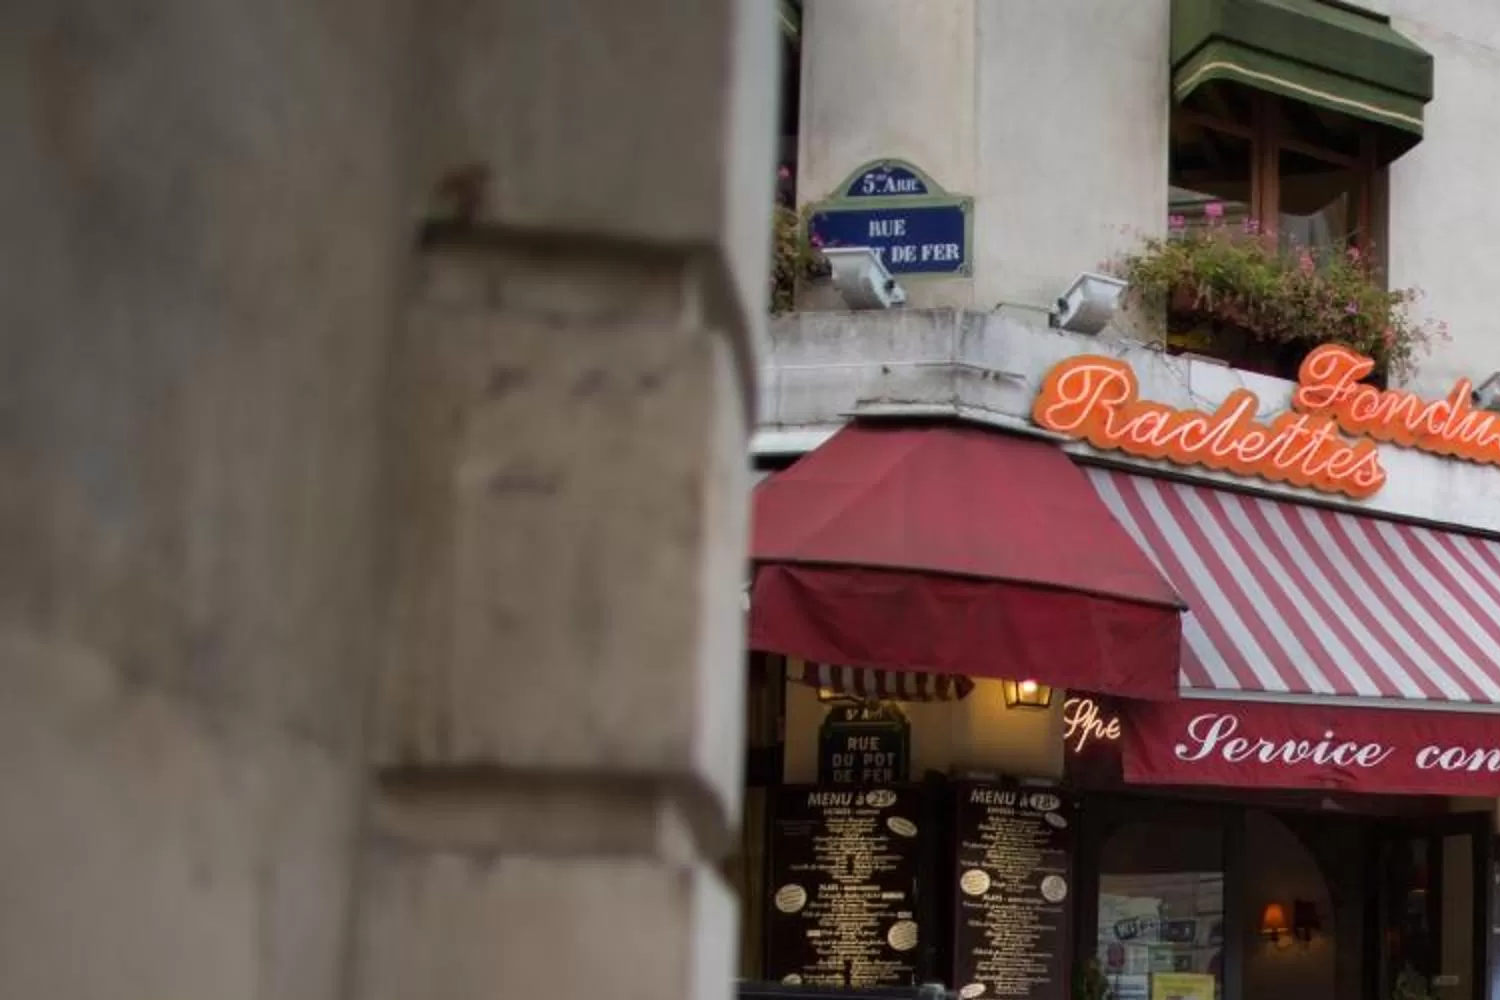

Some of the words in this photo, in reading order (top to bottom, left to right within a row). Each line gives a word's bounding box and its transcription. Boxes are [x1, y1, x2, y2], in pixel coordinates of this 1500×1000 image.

[868, 219, 906, 237] RUE
[891, 245, 917, 263] DE
[921, 243, 960, 262] FER
[1043, 362, 1387, 488] Raclettes
[848, 736, 881, 751] RUE
[1175, 713, 1396, 768] Service
[832, 752, 854, 767] DU
[864, 752, 896, 766] POT
[808, 791, 853, 808] MENU
[970, 788, 1016, 806] MENU
